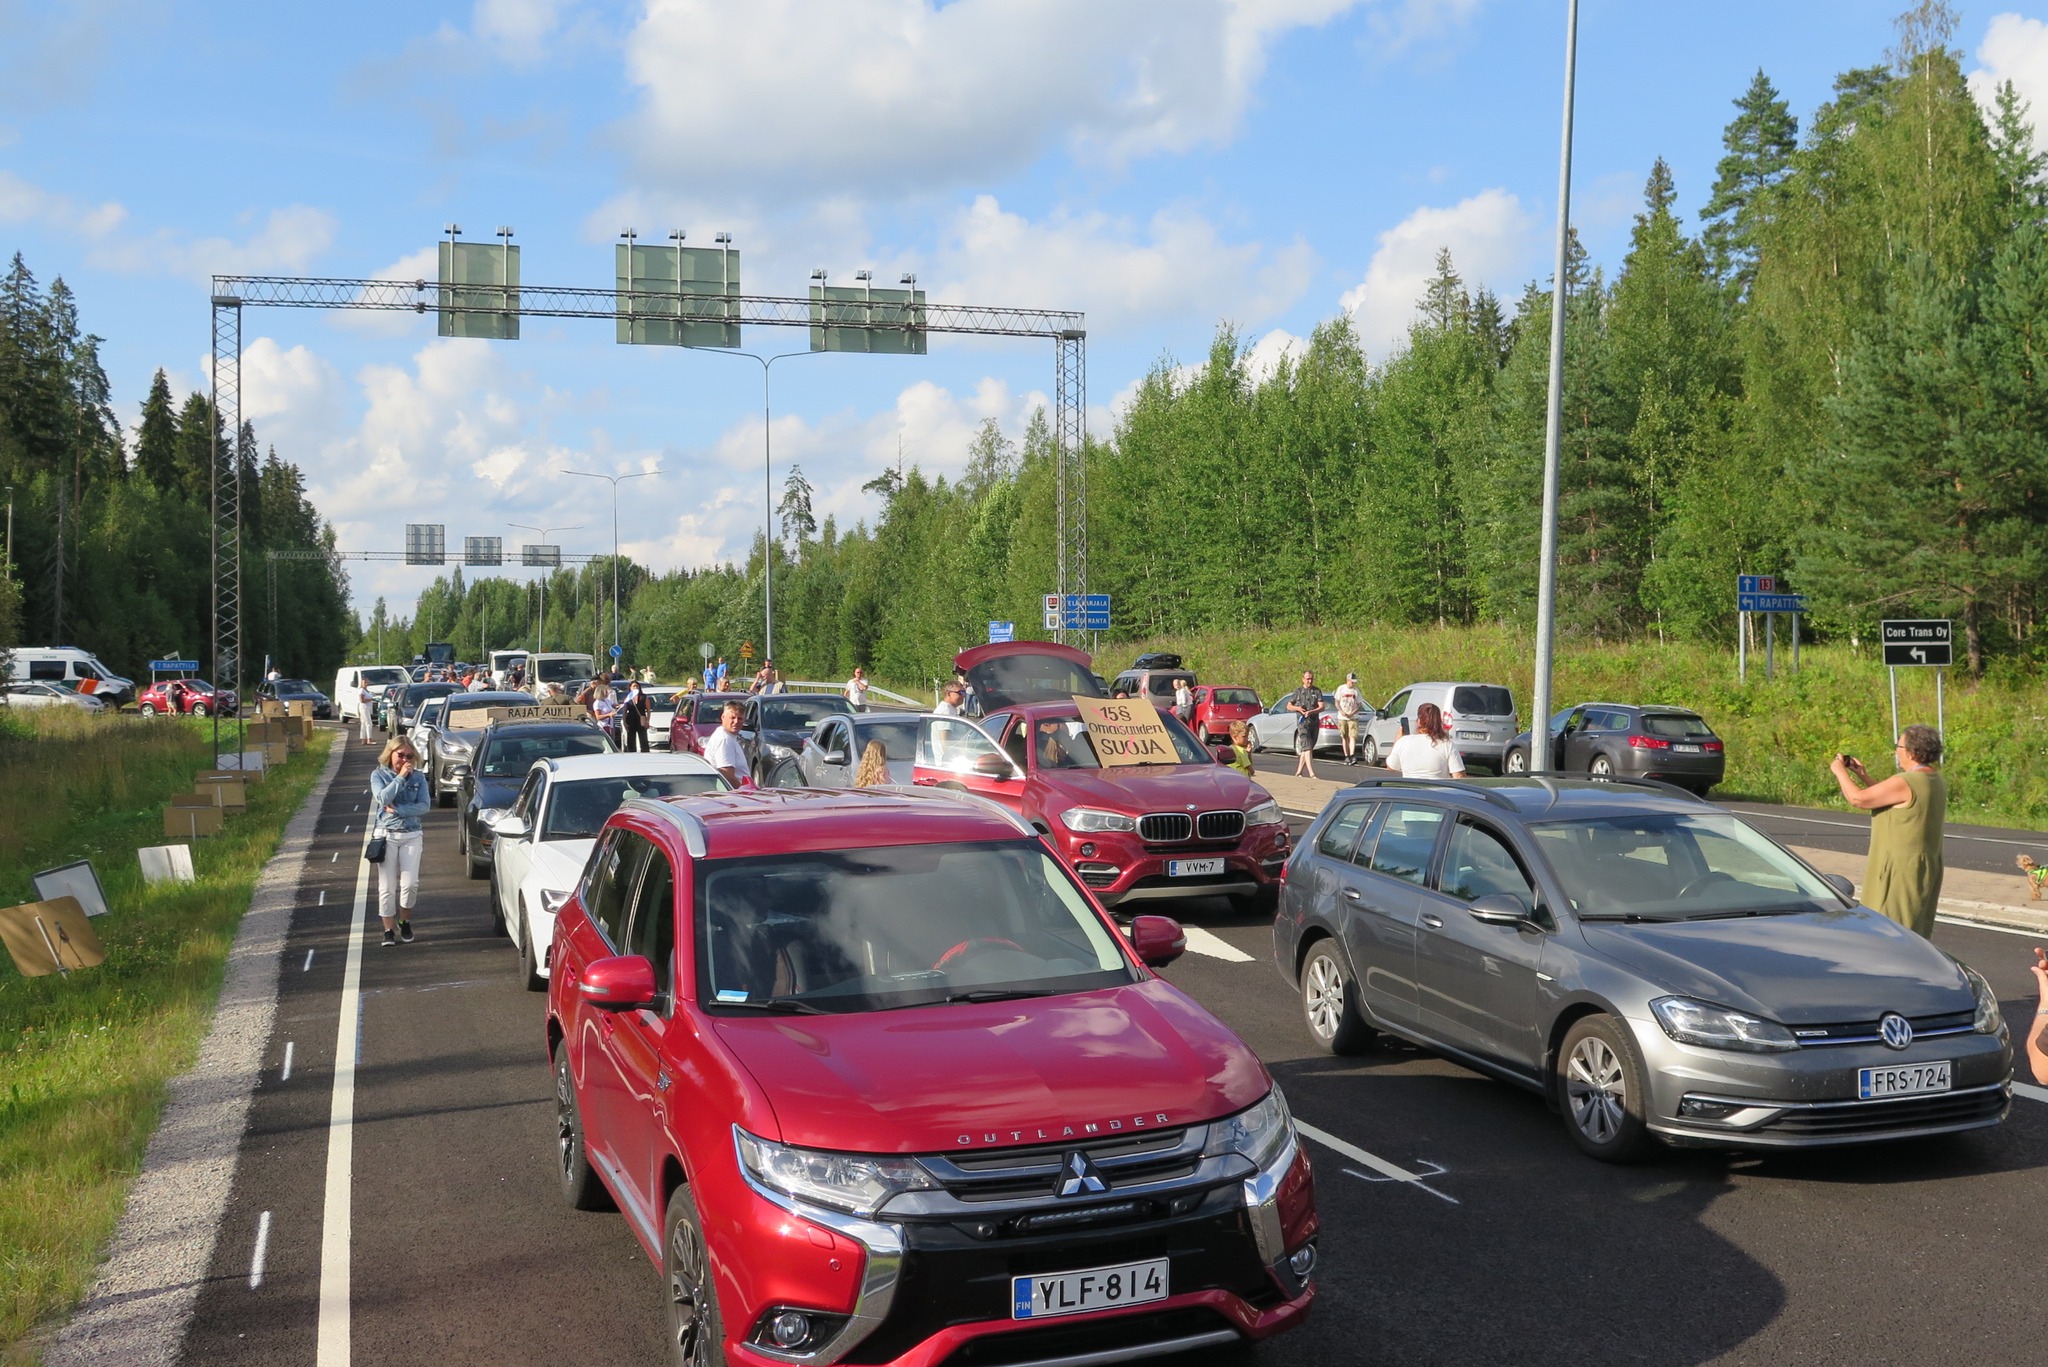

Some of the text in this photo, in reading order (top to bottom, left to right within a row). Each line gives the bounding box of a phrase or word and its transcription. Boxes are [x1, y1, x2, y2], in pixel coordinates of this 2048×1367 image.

[1761, 580, 1771, 590] 13
[1760, 598, 1802, 609] RAPATTIL
[1886, 626, 1948, 639] Core Trans Oy
[508, 706, 572, 718] RAJAT AUKI!
[1101, 738, 1167, 755] SUOJA
[1186, 861, 1215, 873] VVM-7
[1875, 1067, 1947, 1093] FRS-724
[957, 1113, 1169, 1145] OUTLANDER
[1016, 1267, 1161, 1310] FIN YLF-814
